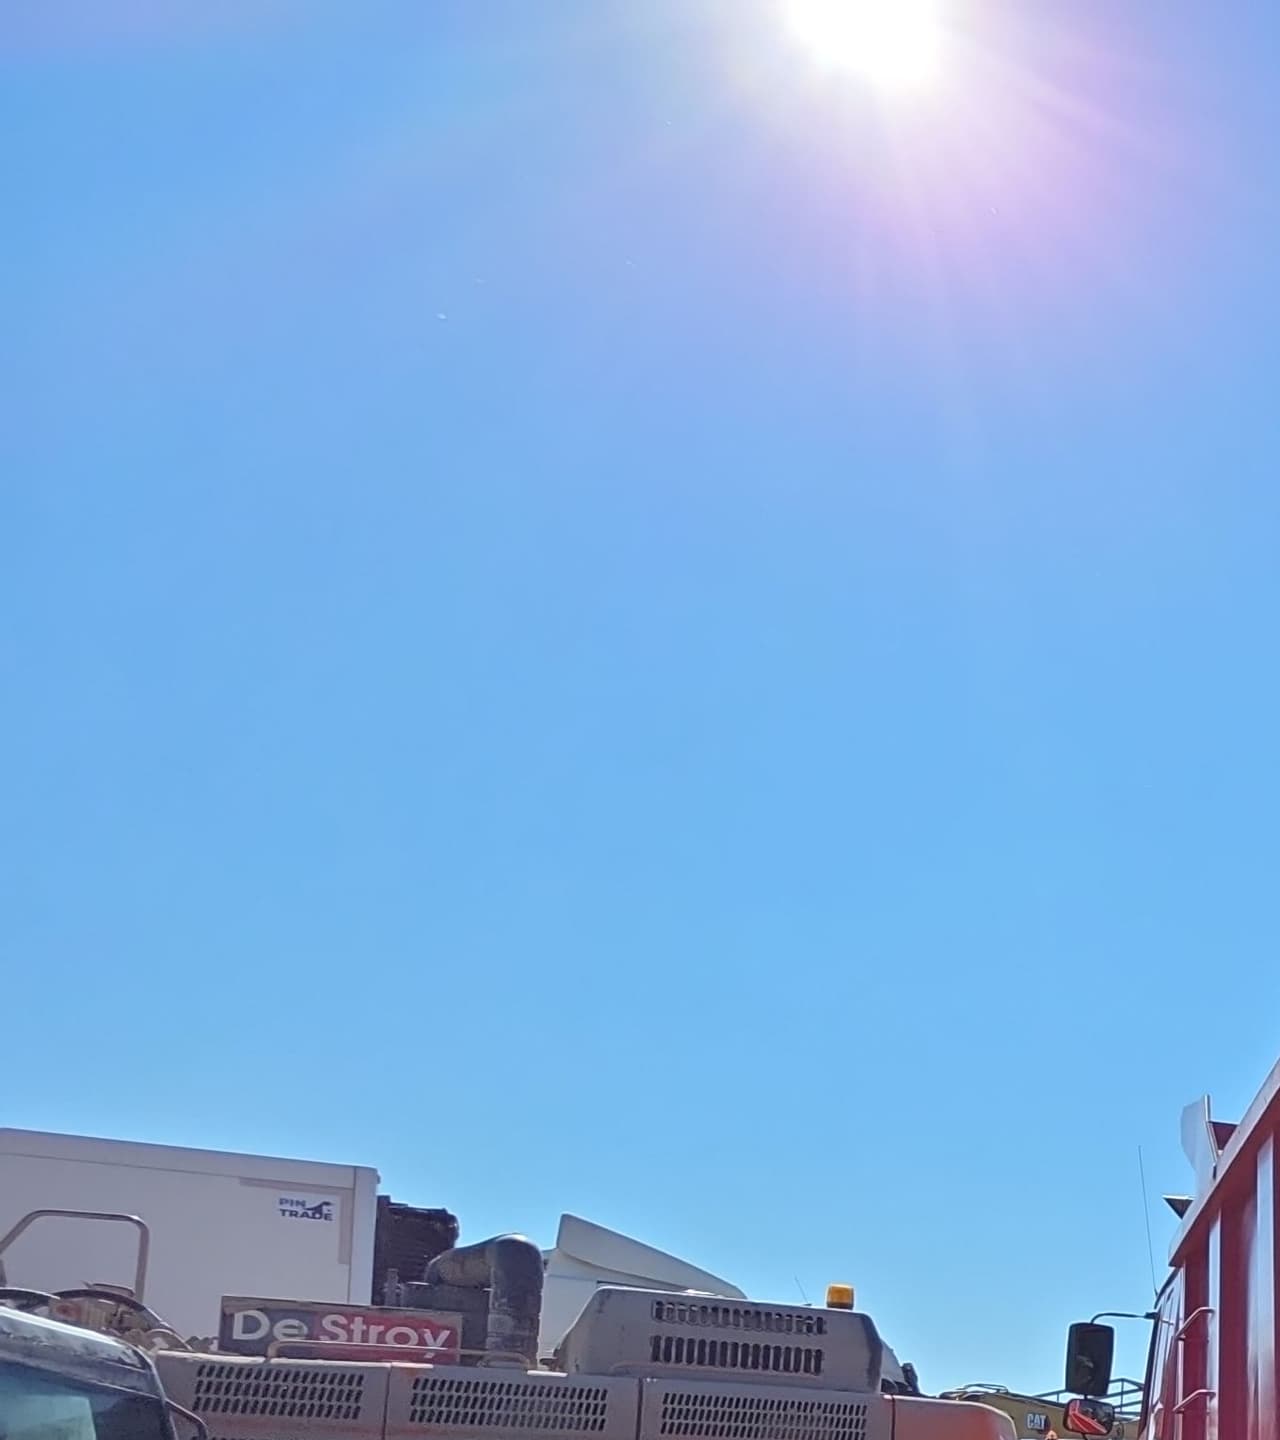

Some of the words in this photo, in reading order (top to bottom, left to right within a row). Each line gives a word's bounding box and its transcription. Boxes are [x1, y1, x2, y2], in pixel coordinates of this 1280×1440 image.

[279, 1198, 306, 1207] PIN
[279, 1208, 333, 1221] TRADE
[232, 1309, 309, 1342] De
[1027, 1413, 1047, 1430] CAT
